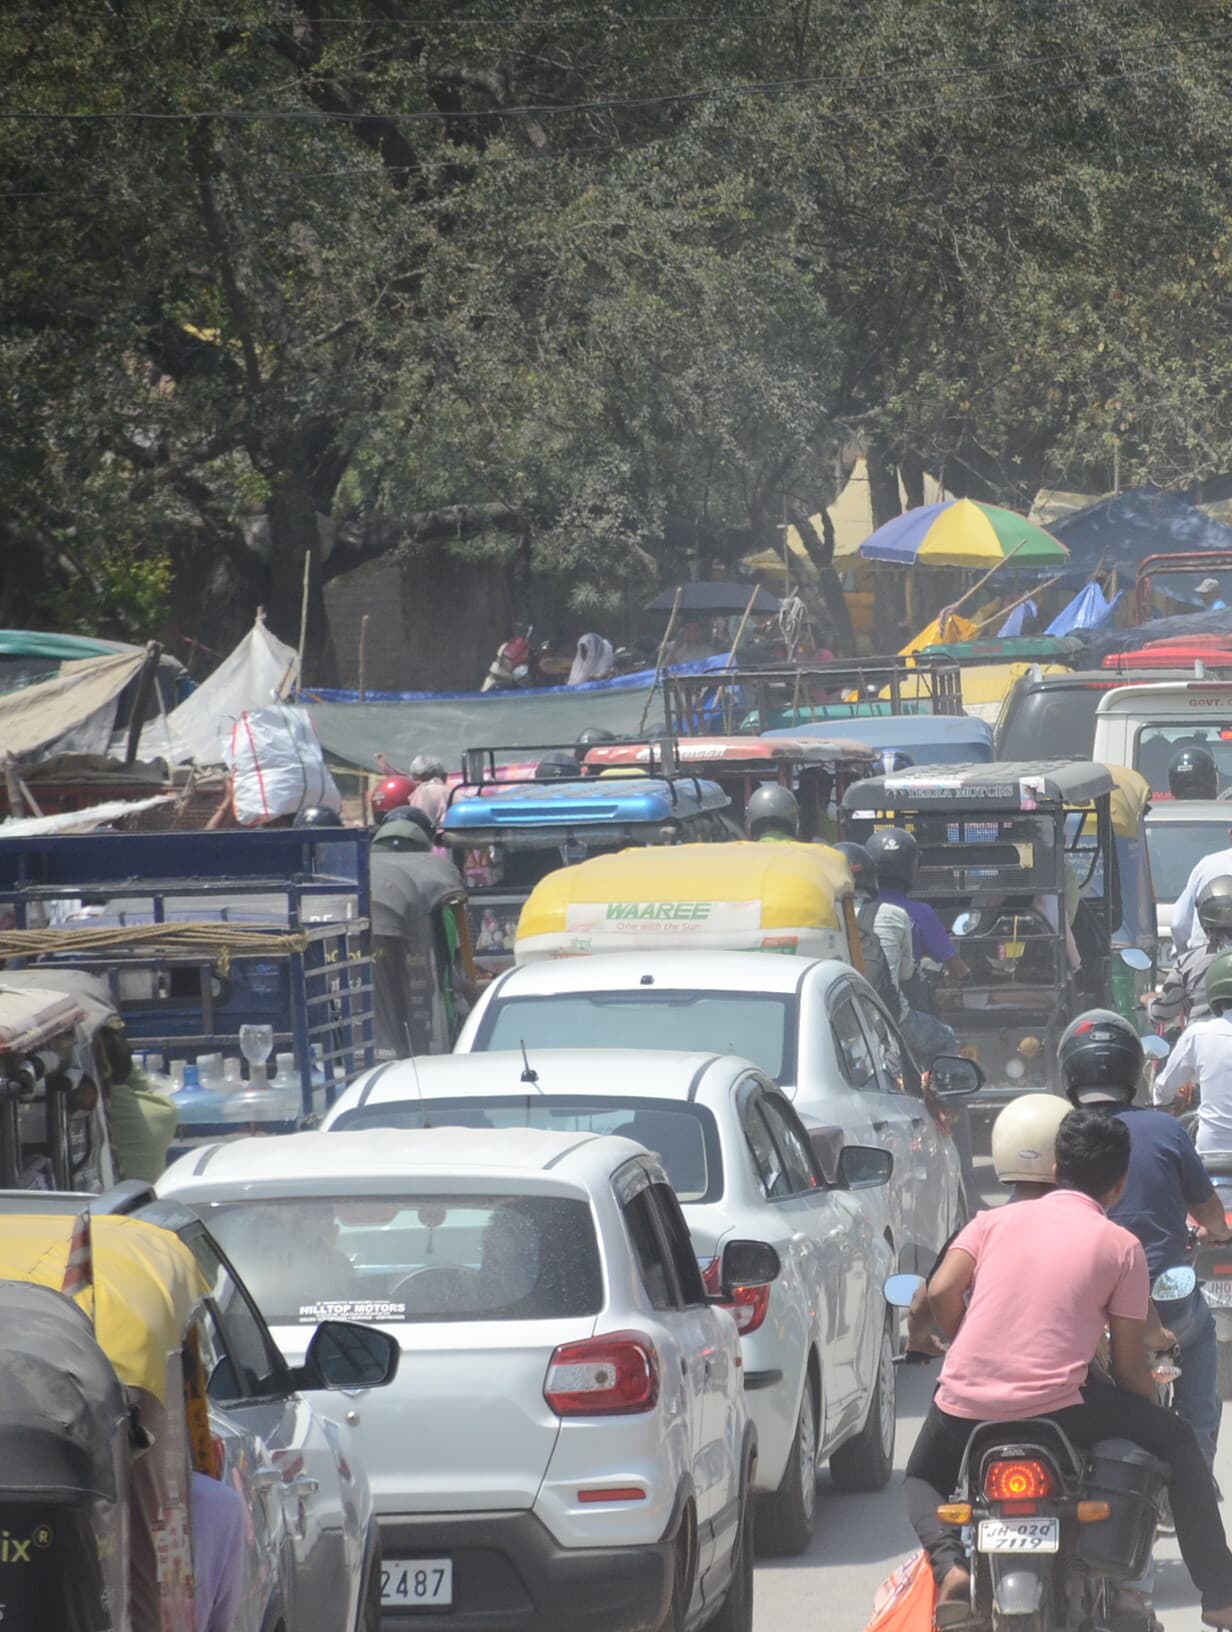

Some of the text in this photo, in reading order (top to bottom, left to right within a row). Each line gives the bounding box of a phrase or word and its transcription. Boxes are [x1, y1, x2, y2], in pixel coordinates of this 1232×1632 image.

[605, 902, 712, 920] WAAREE
[616, 921, 637, 931] One
[639, 921, 660, 931] with
[663, 921, 680, 931] the
[300, 1303, 406, 1315] HILLTOP MOTORS
[995, 1538, 1043, 1548] 7119
[380, 1568, 445, 1599] 2487
